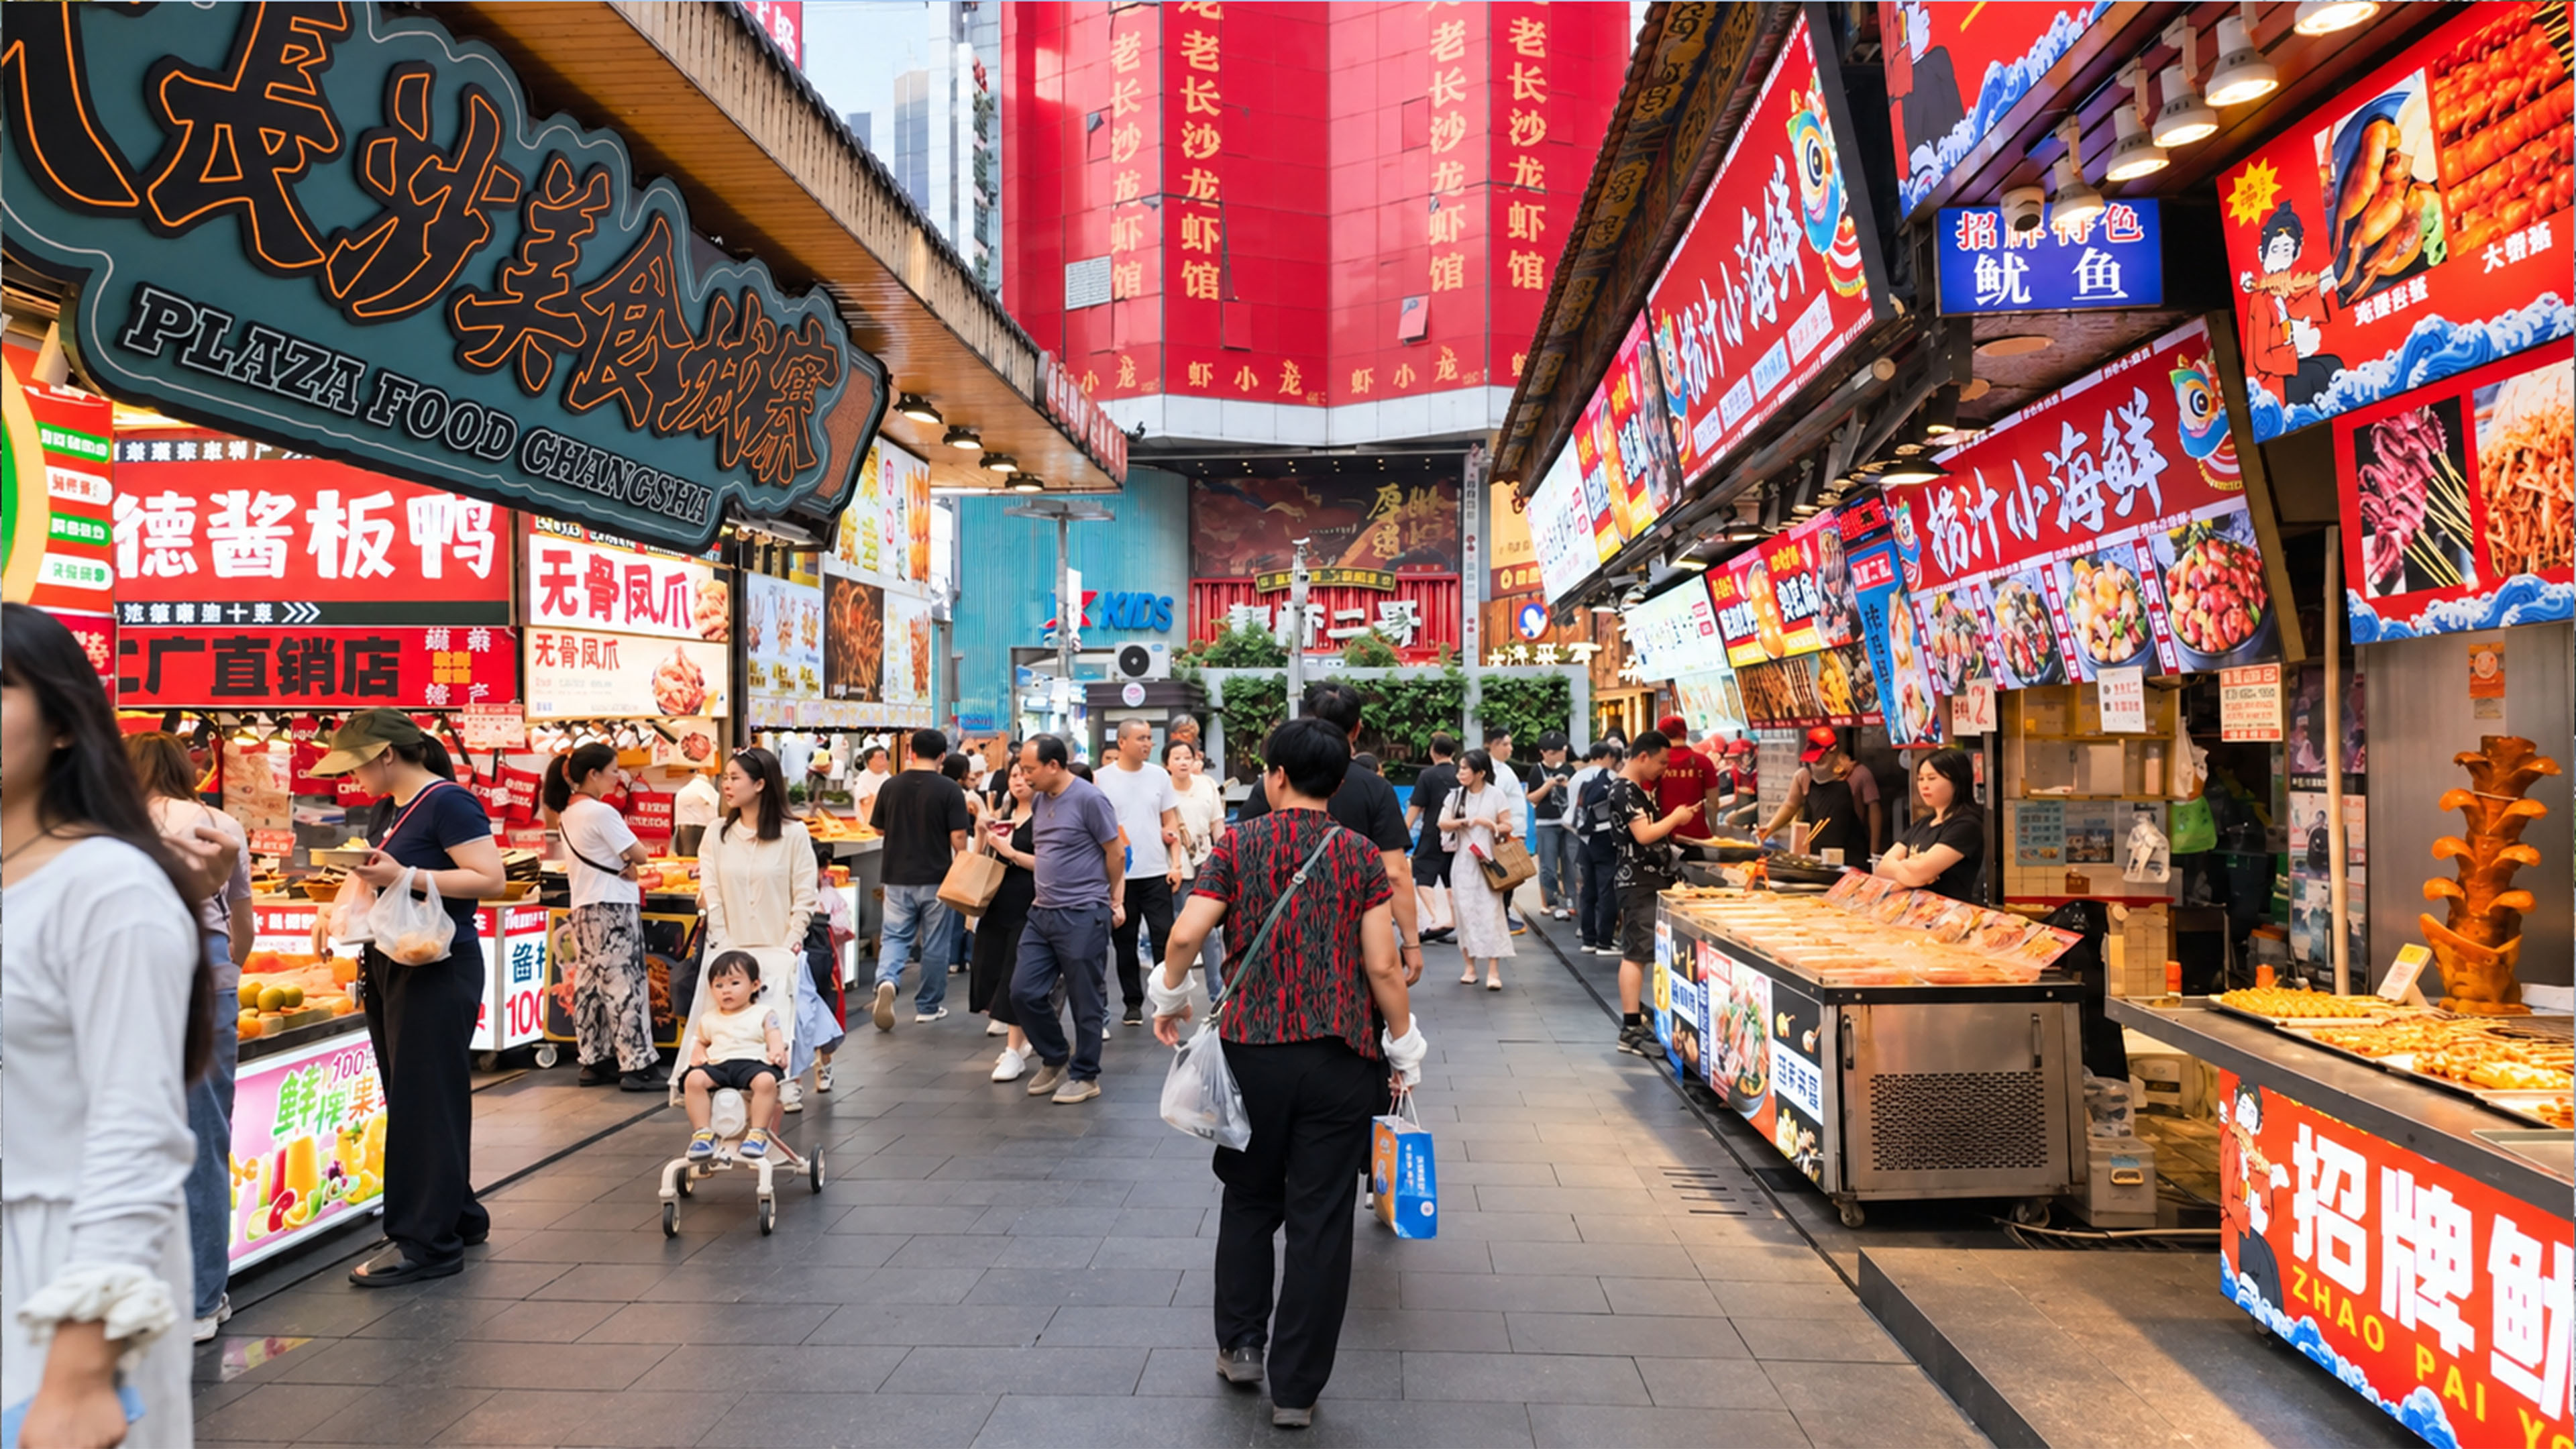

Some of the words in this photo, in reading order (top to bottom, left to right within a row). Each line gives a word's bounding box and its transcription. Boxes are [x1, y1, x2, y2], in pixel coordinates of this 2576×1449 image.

[1110, 2, 1144, 300] 老长沙龙虾馆
[1507, 2, 1548, 290] 老长沙龙虾馆
[1, 1, 840, 486] 長沙美食城寨
[1974, 246, 2129, 306] 鱿鱼
[124, 287, 366, 415] PLAZA
[368, 372, 519, 460] FOOD
[521, 429, 713, 526] CHANGSHA
[112, 489, 496, 579] 德酱板鸭
[539, 548, 692, 630] 无骨凤爪
[1099, 591, 1174, 633] KIDS
[535, 633, 621, 671] 无骨凤爪
[2292, 1122, 2575, 1421] 招牌鱿
[2292, 1265, 2385, 1353] ZHAO
[2416, 1343, 2486, 1422] PAI
